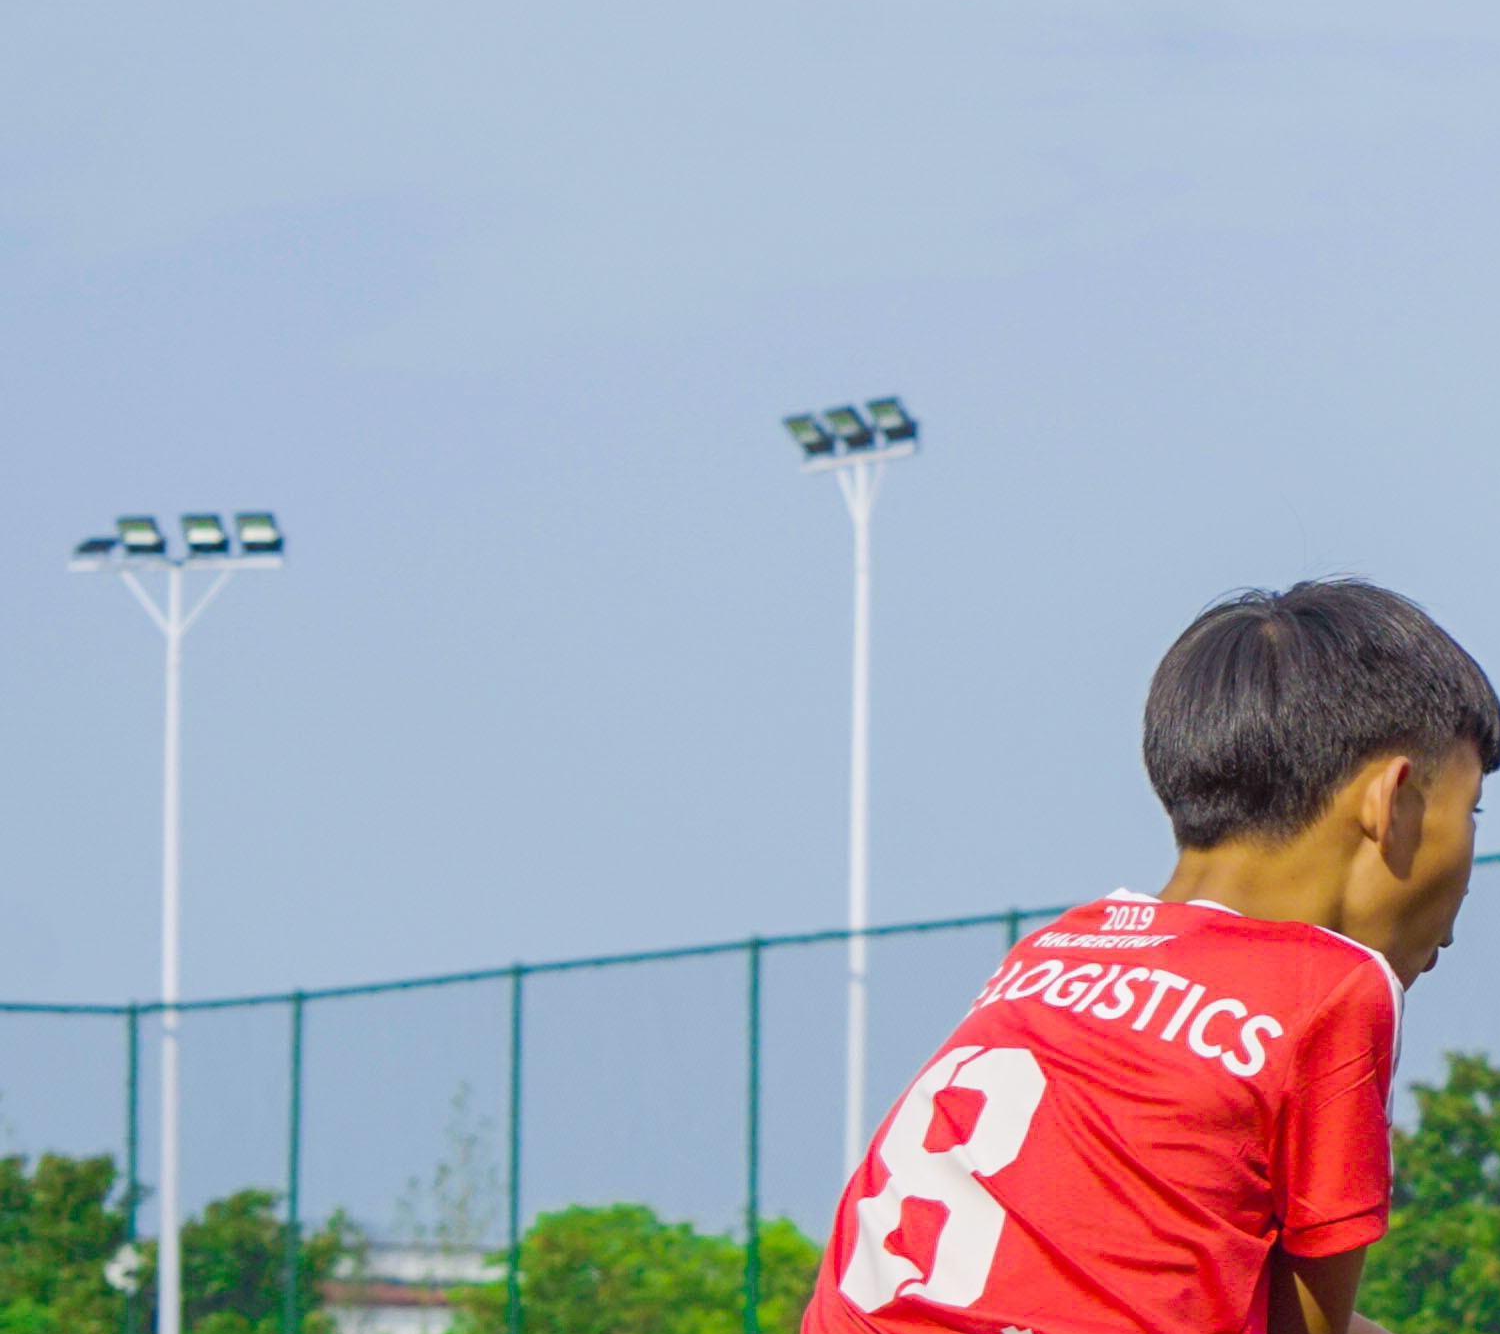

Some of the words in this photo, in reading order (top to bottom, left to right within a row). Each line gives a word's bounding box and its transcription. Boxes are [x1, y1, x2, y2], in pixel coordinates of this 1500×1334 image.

[1032, 931, 1177, 949] HALBERSTADT
[1100, 905, 1155, 931] 2019
[981, 959, 1284, 1078] LOGISTICS
[838, 1045, 1047, 1313] 8
